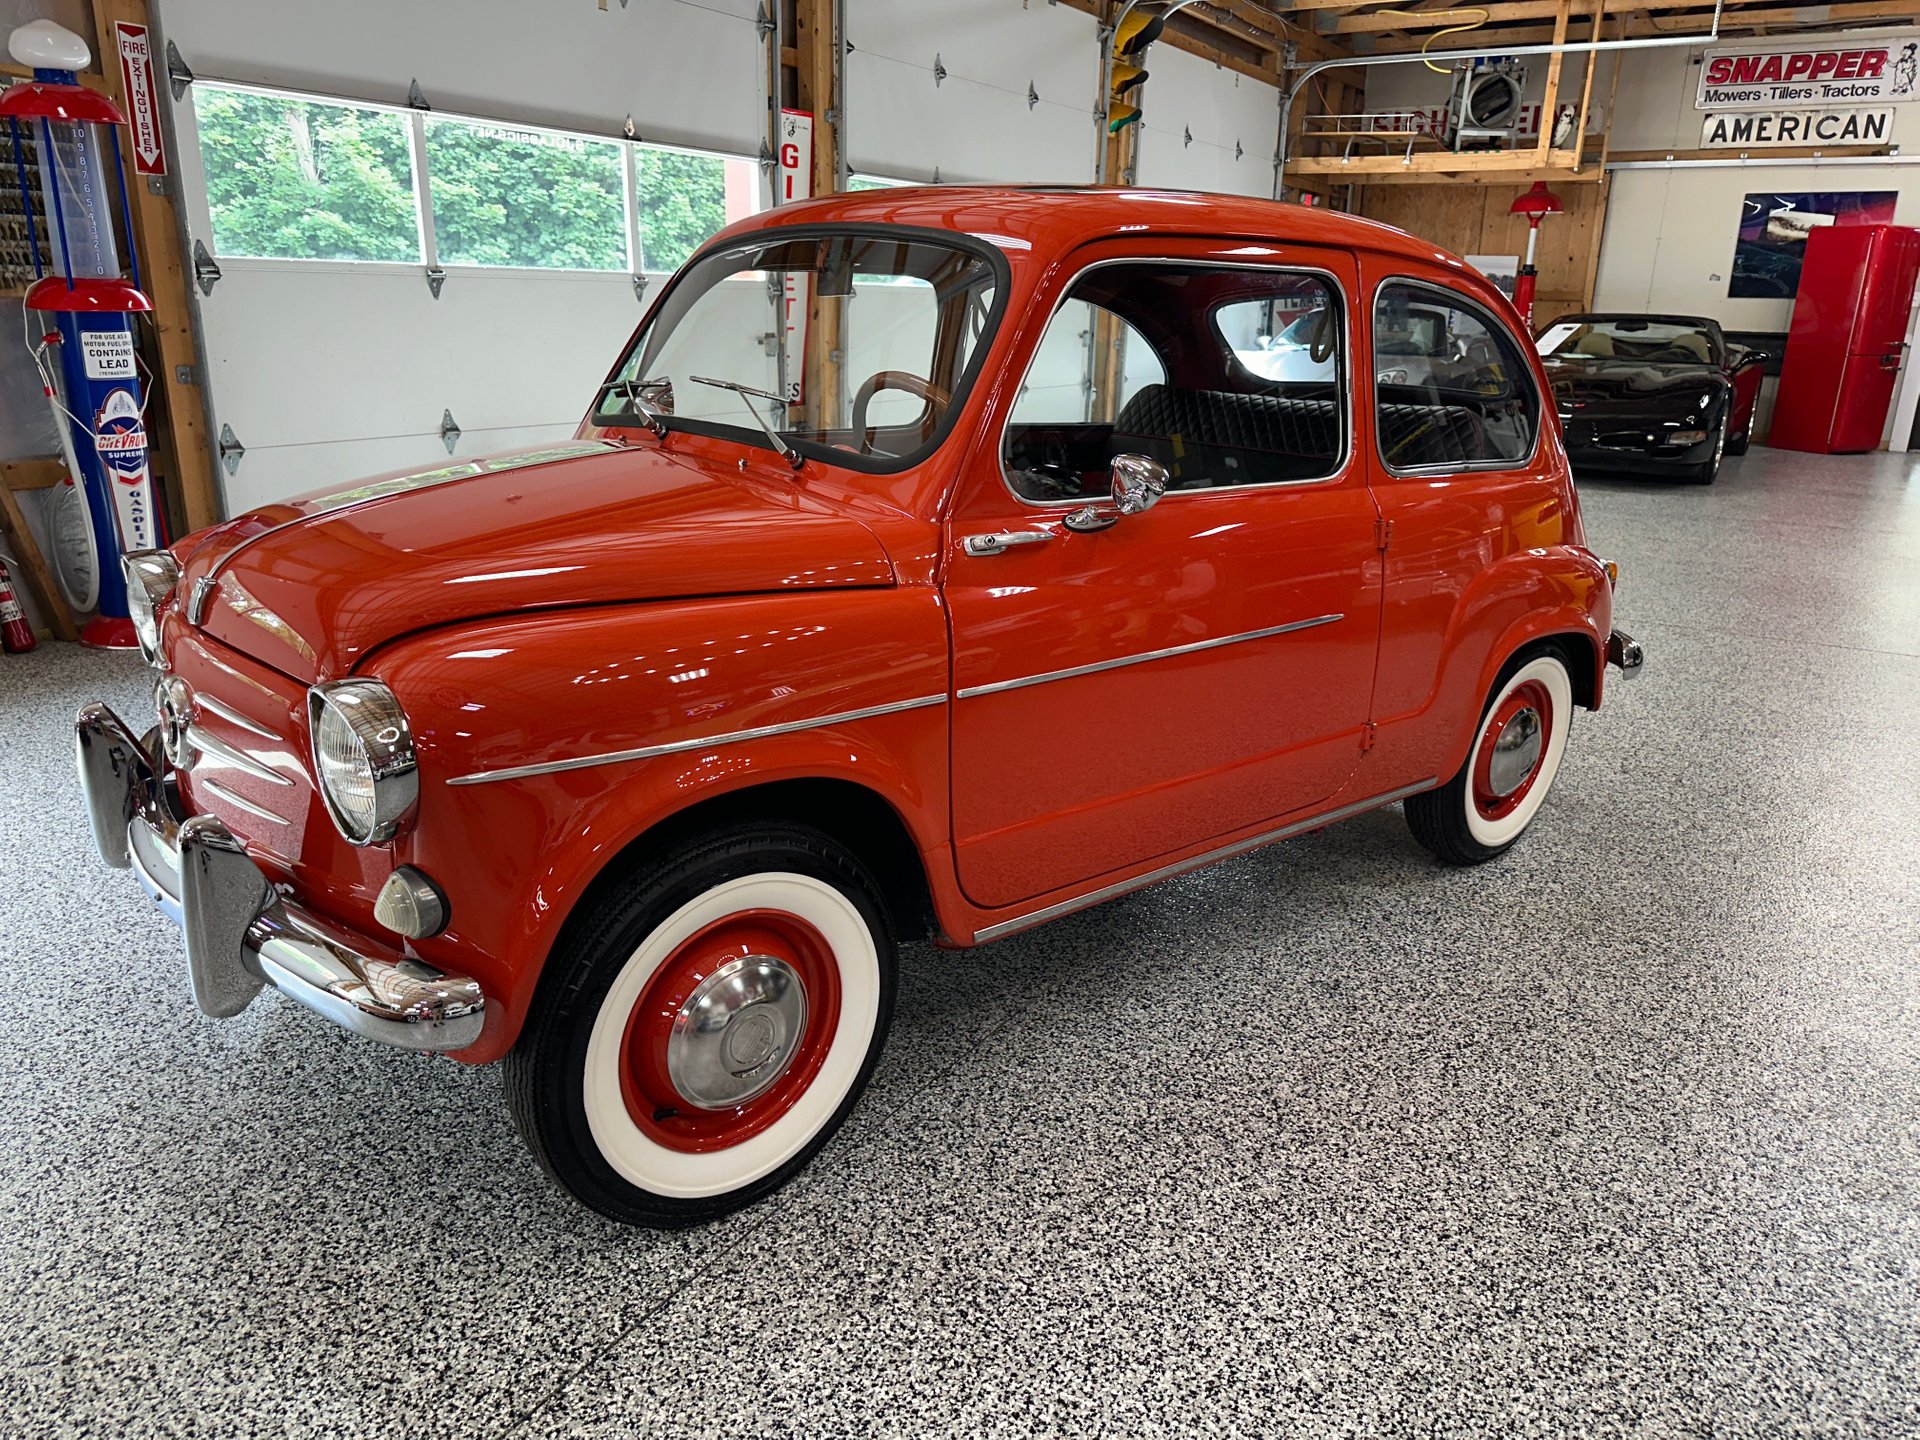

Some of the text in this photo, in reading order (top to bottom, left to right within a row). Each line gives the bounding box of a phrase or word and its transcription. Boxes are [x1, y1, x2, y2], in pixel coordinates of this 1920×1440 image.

[122, 40, 147, 56] FIRE
[1706, 50, 1889, 85] SNAPPER
[1703, 84, 1880, 103] Mowers Tillers Tractors
[131, 57, 153, 154] EXTINGUISHER
[72, 128, 85, 138] 10
[1709, 113, 1886, 143] AMERICAN
[77, 143, 85, 152] 9
[79, 156, 87, 166] 8
[81, 170, 88, 180] 7
[84, 183, 91, 193] 6
[86, 198, 93, 207] 5
[93, 239, 100, 249] 2
[95, 252, 101, 261] 1
[96, 265, 104, 275] 0
[89, 348, 132, 357] CONTAINS
[98, 359, 129, 369] LEAD
[98, 433, 146, 449] CHEVRON
